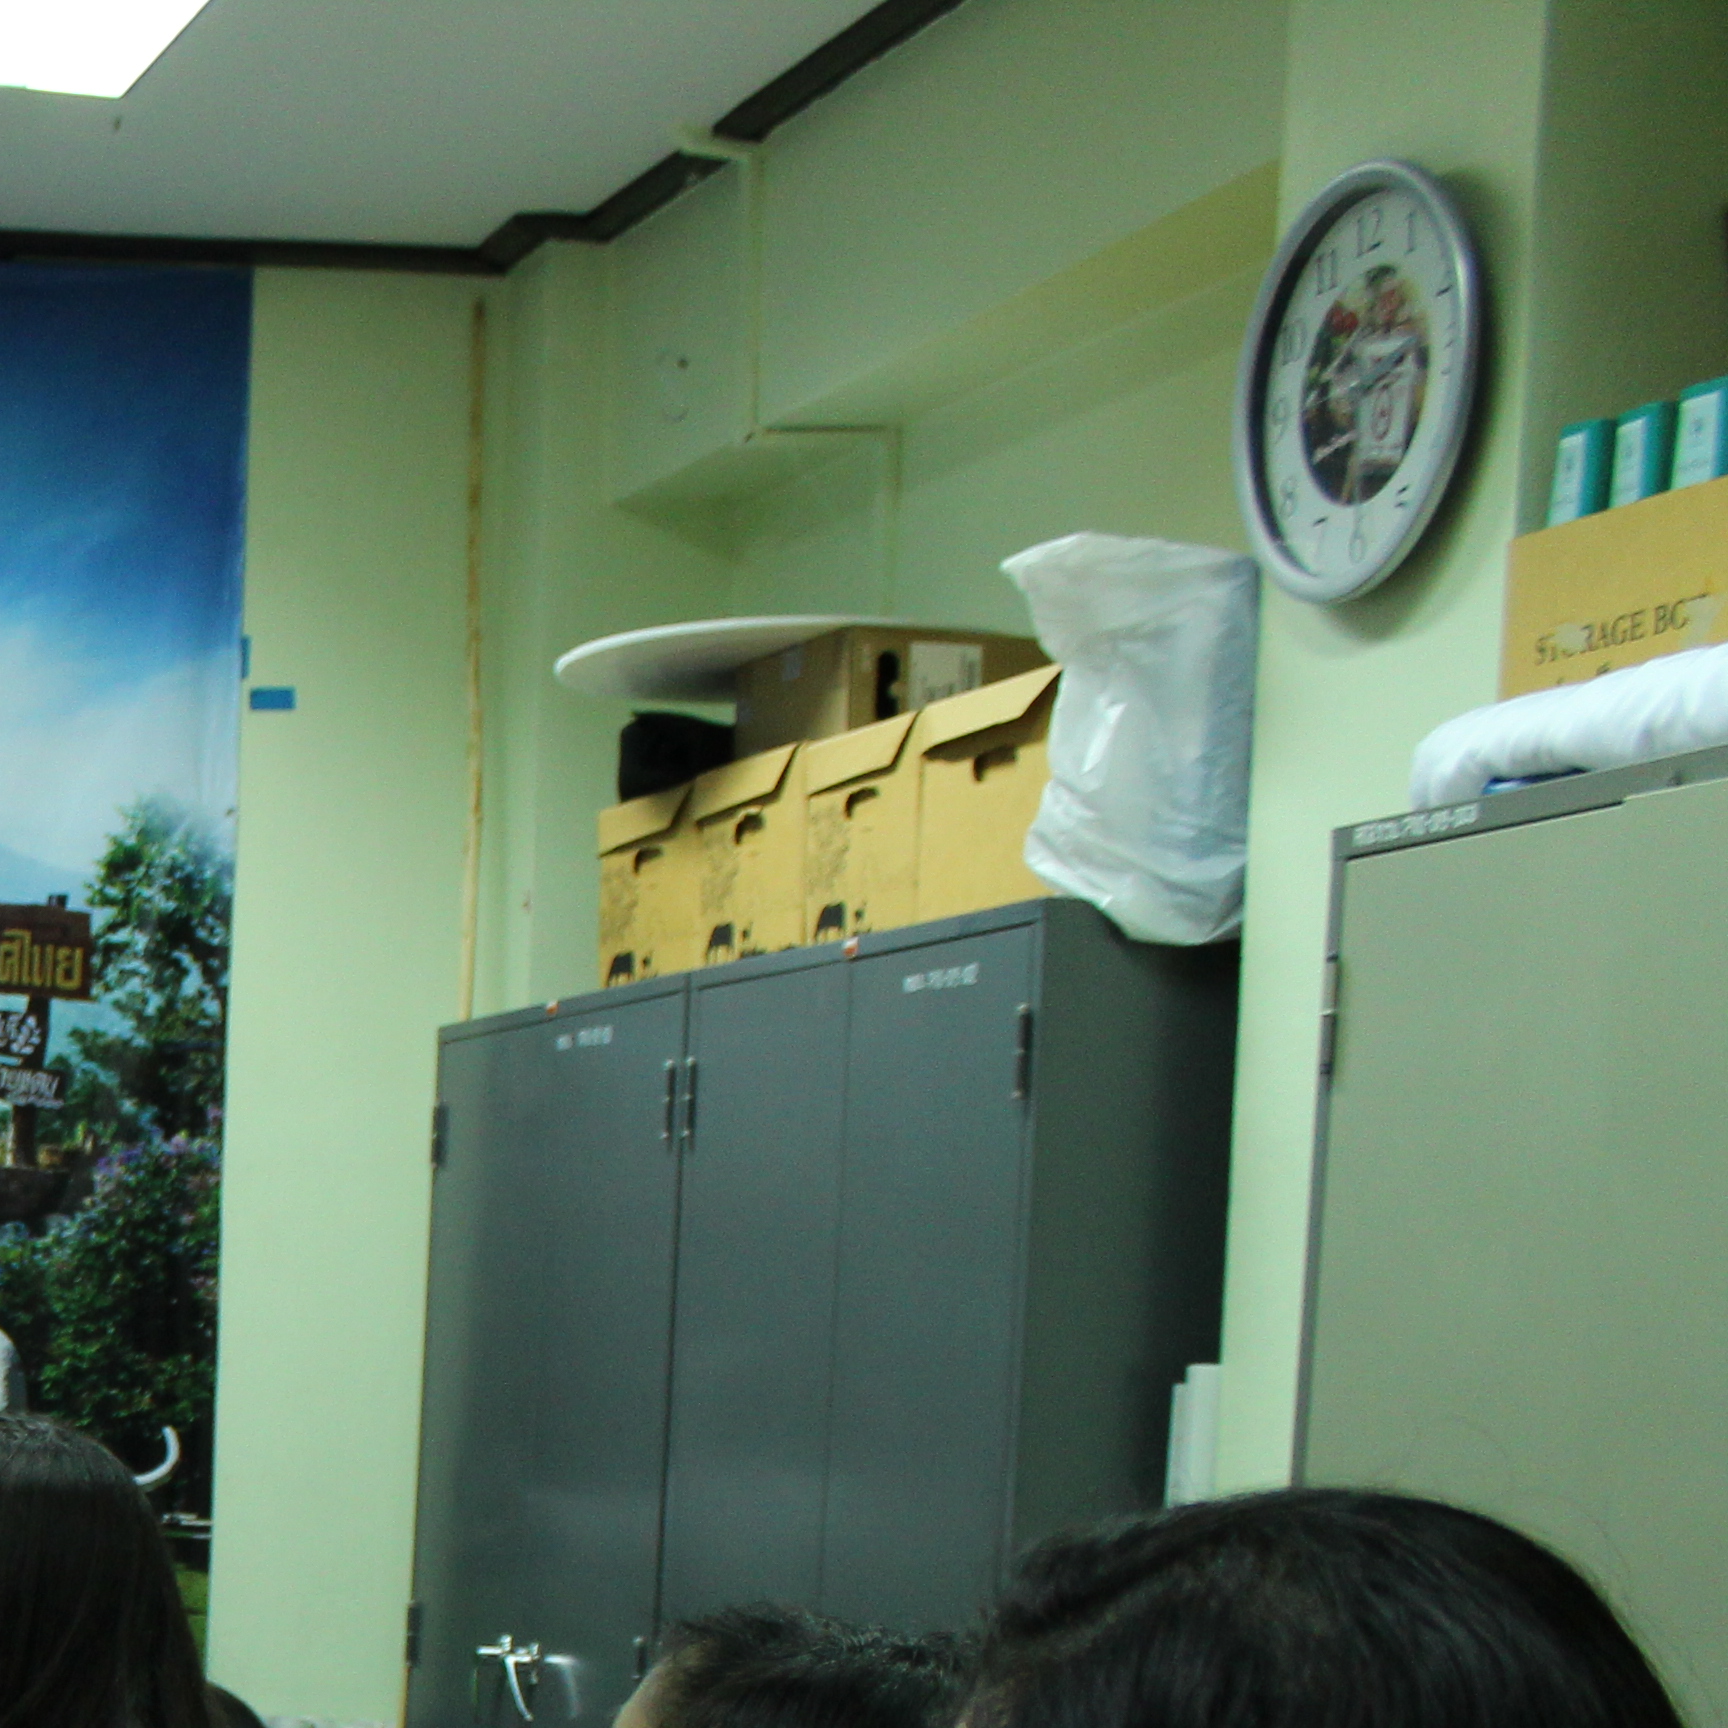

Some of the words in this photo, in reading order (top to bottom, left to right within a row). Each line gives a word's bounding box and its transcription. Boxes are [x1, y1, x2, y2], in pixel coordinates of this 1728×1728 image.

[1356, 206, 1383, 257] 12
[1316, 249, 1340, 297] 11
[1535, 608, 1646, 667] STRAGE
